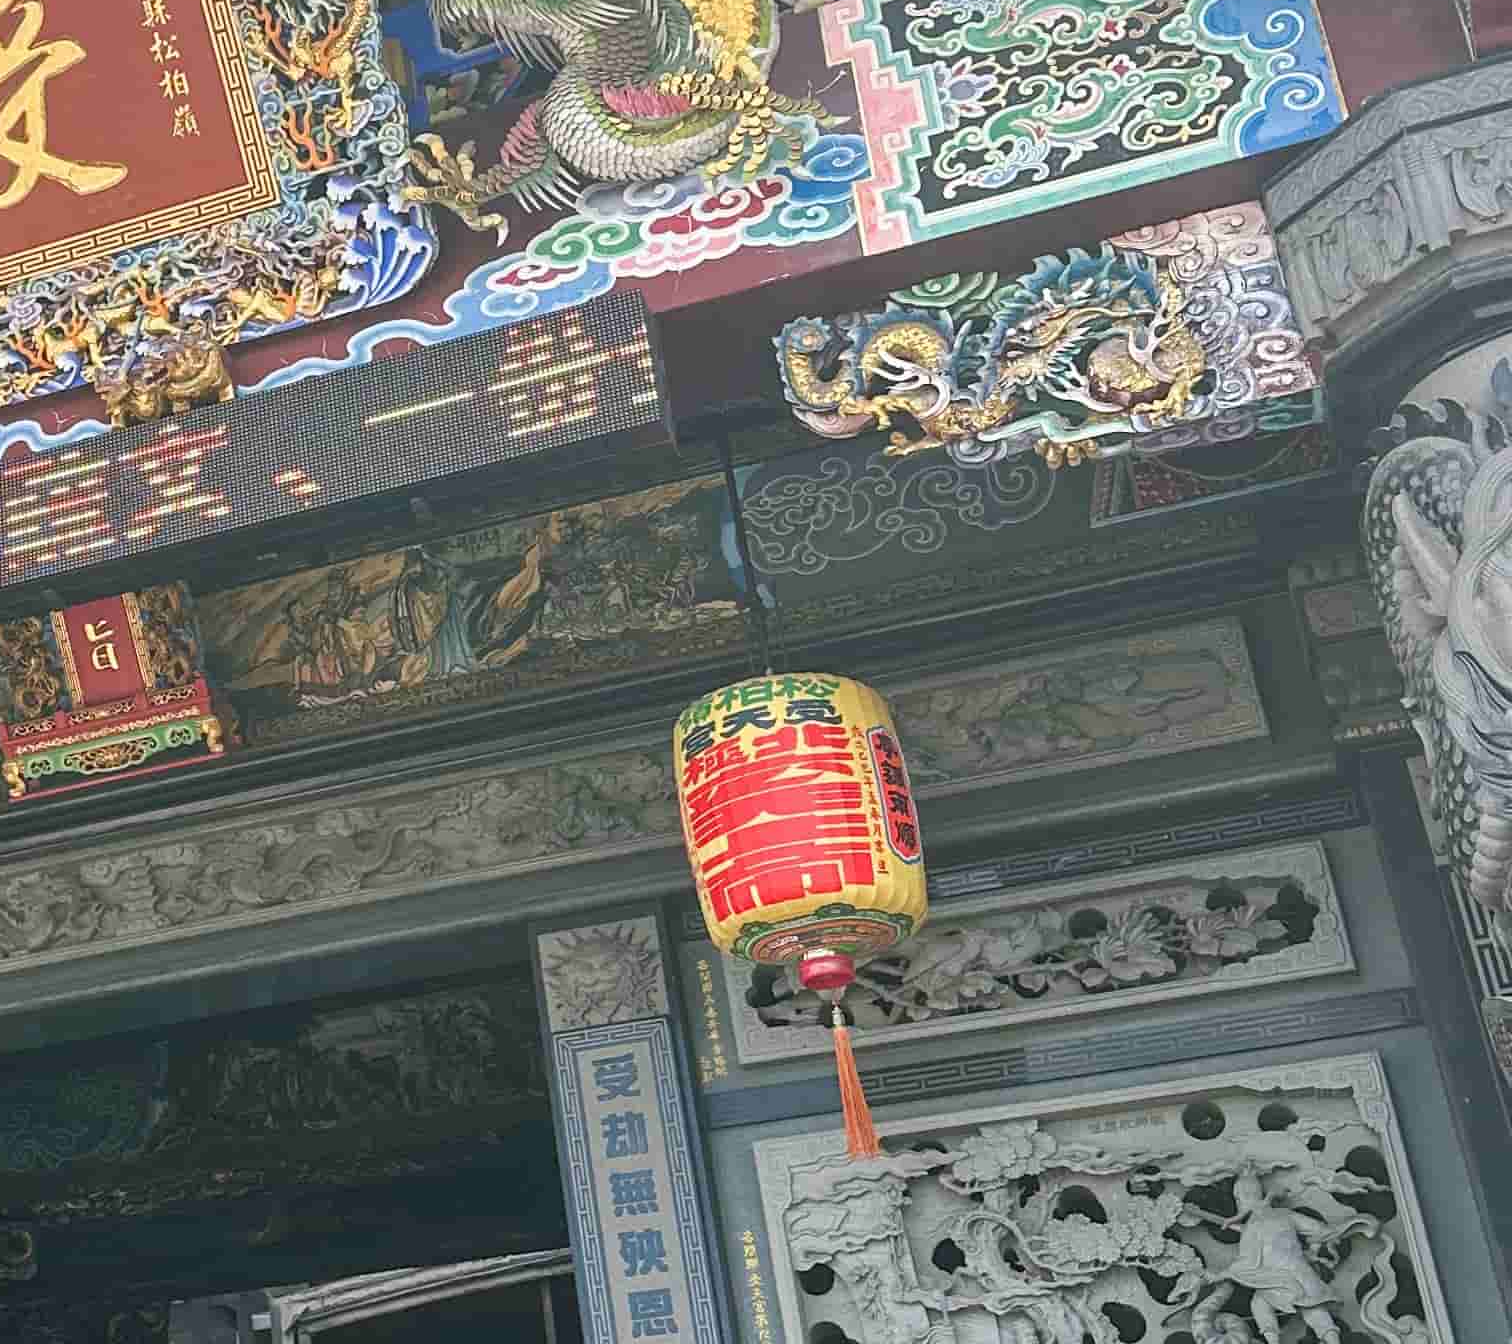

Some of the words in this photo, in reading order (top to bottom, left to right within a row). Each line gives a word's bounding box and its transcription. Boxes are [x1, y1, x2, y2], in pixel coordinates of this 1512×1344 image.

[84, 620, 120, 671] 旨
[682, 699, 843, 762] 受天宮
